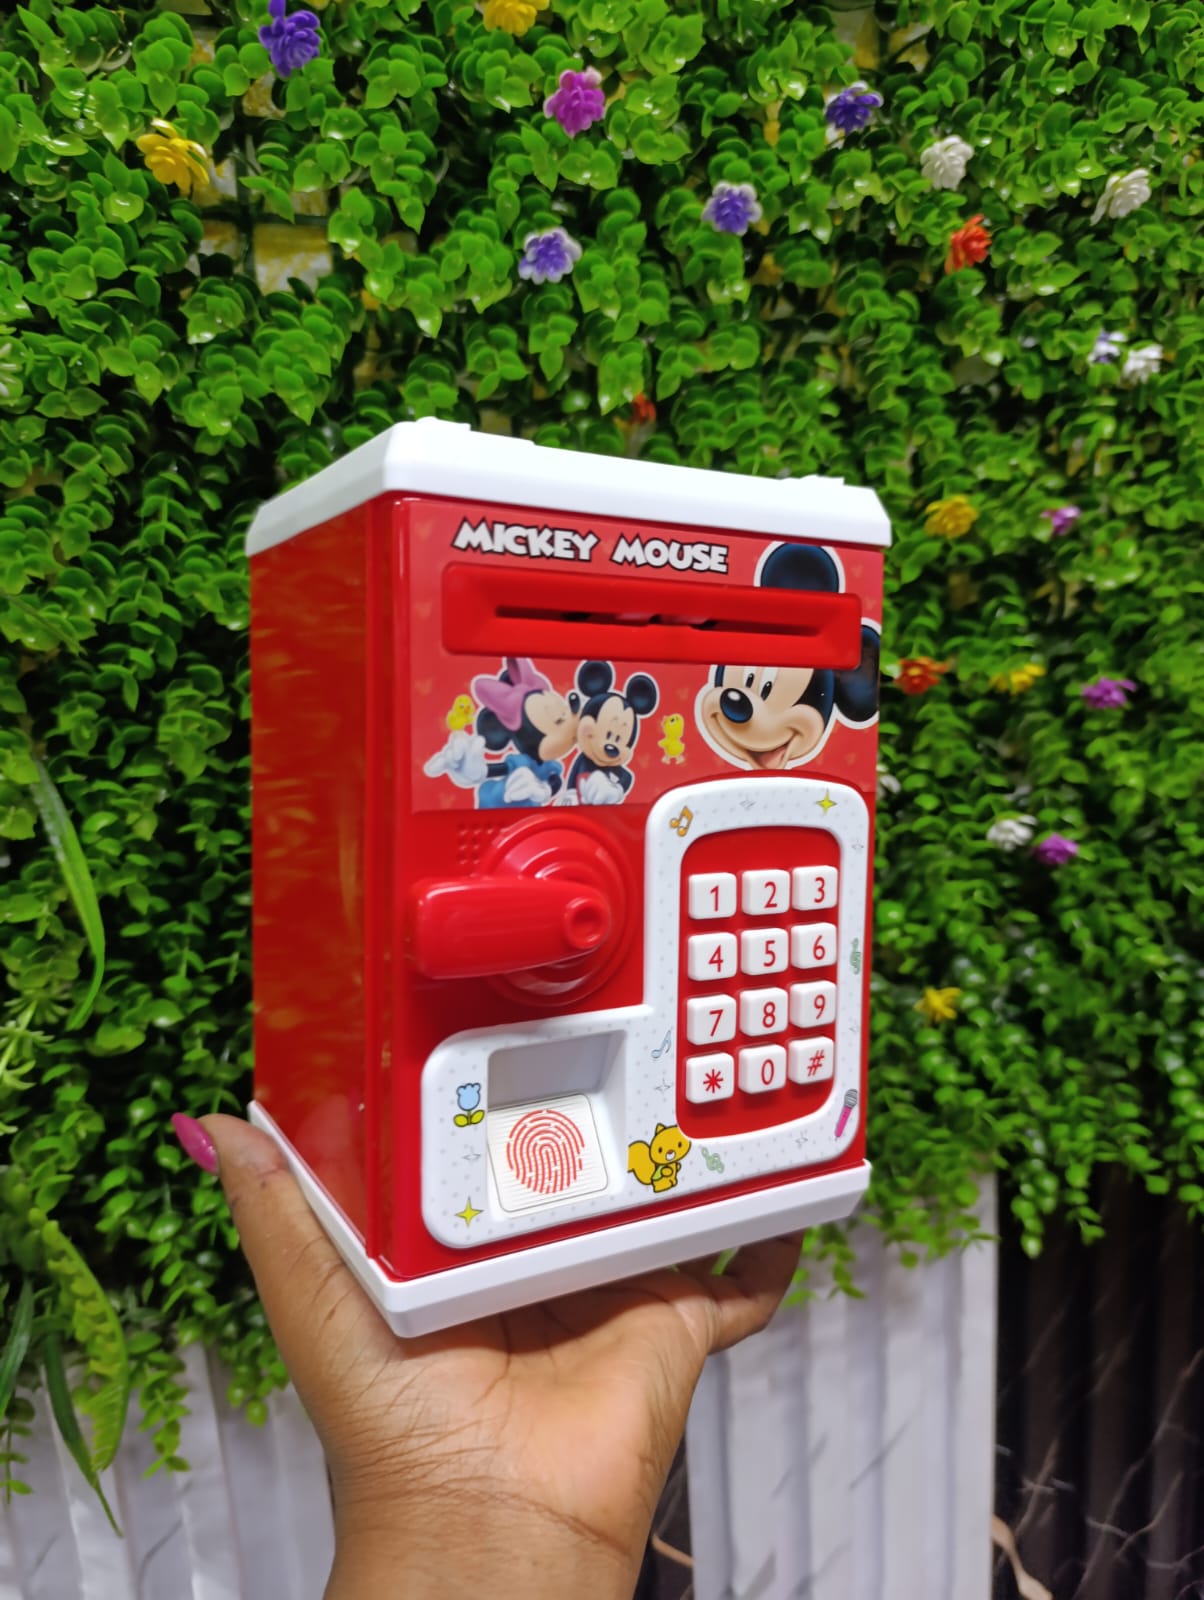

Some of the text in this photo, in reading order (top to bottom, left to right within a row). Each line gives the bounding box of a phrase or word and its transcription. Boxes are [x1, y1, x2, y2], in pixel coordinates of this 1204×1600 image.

[452, 517, 729, 574] MICKEY MOUSE
[709, 877, 826, 912] 1 2 3
[708, 934, 826, 973] 4 5 6
[709, 994, 826, 1037] 7 8 9
